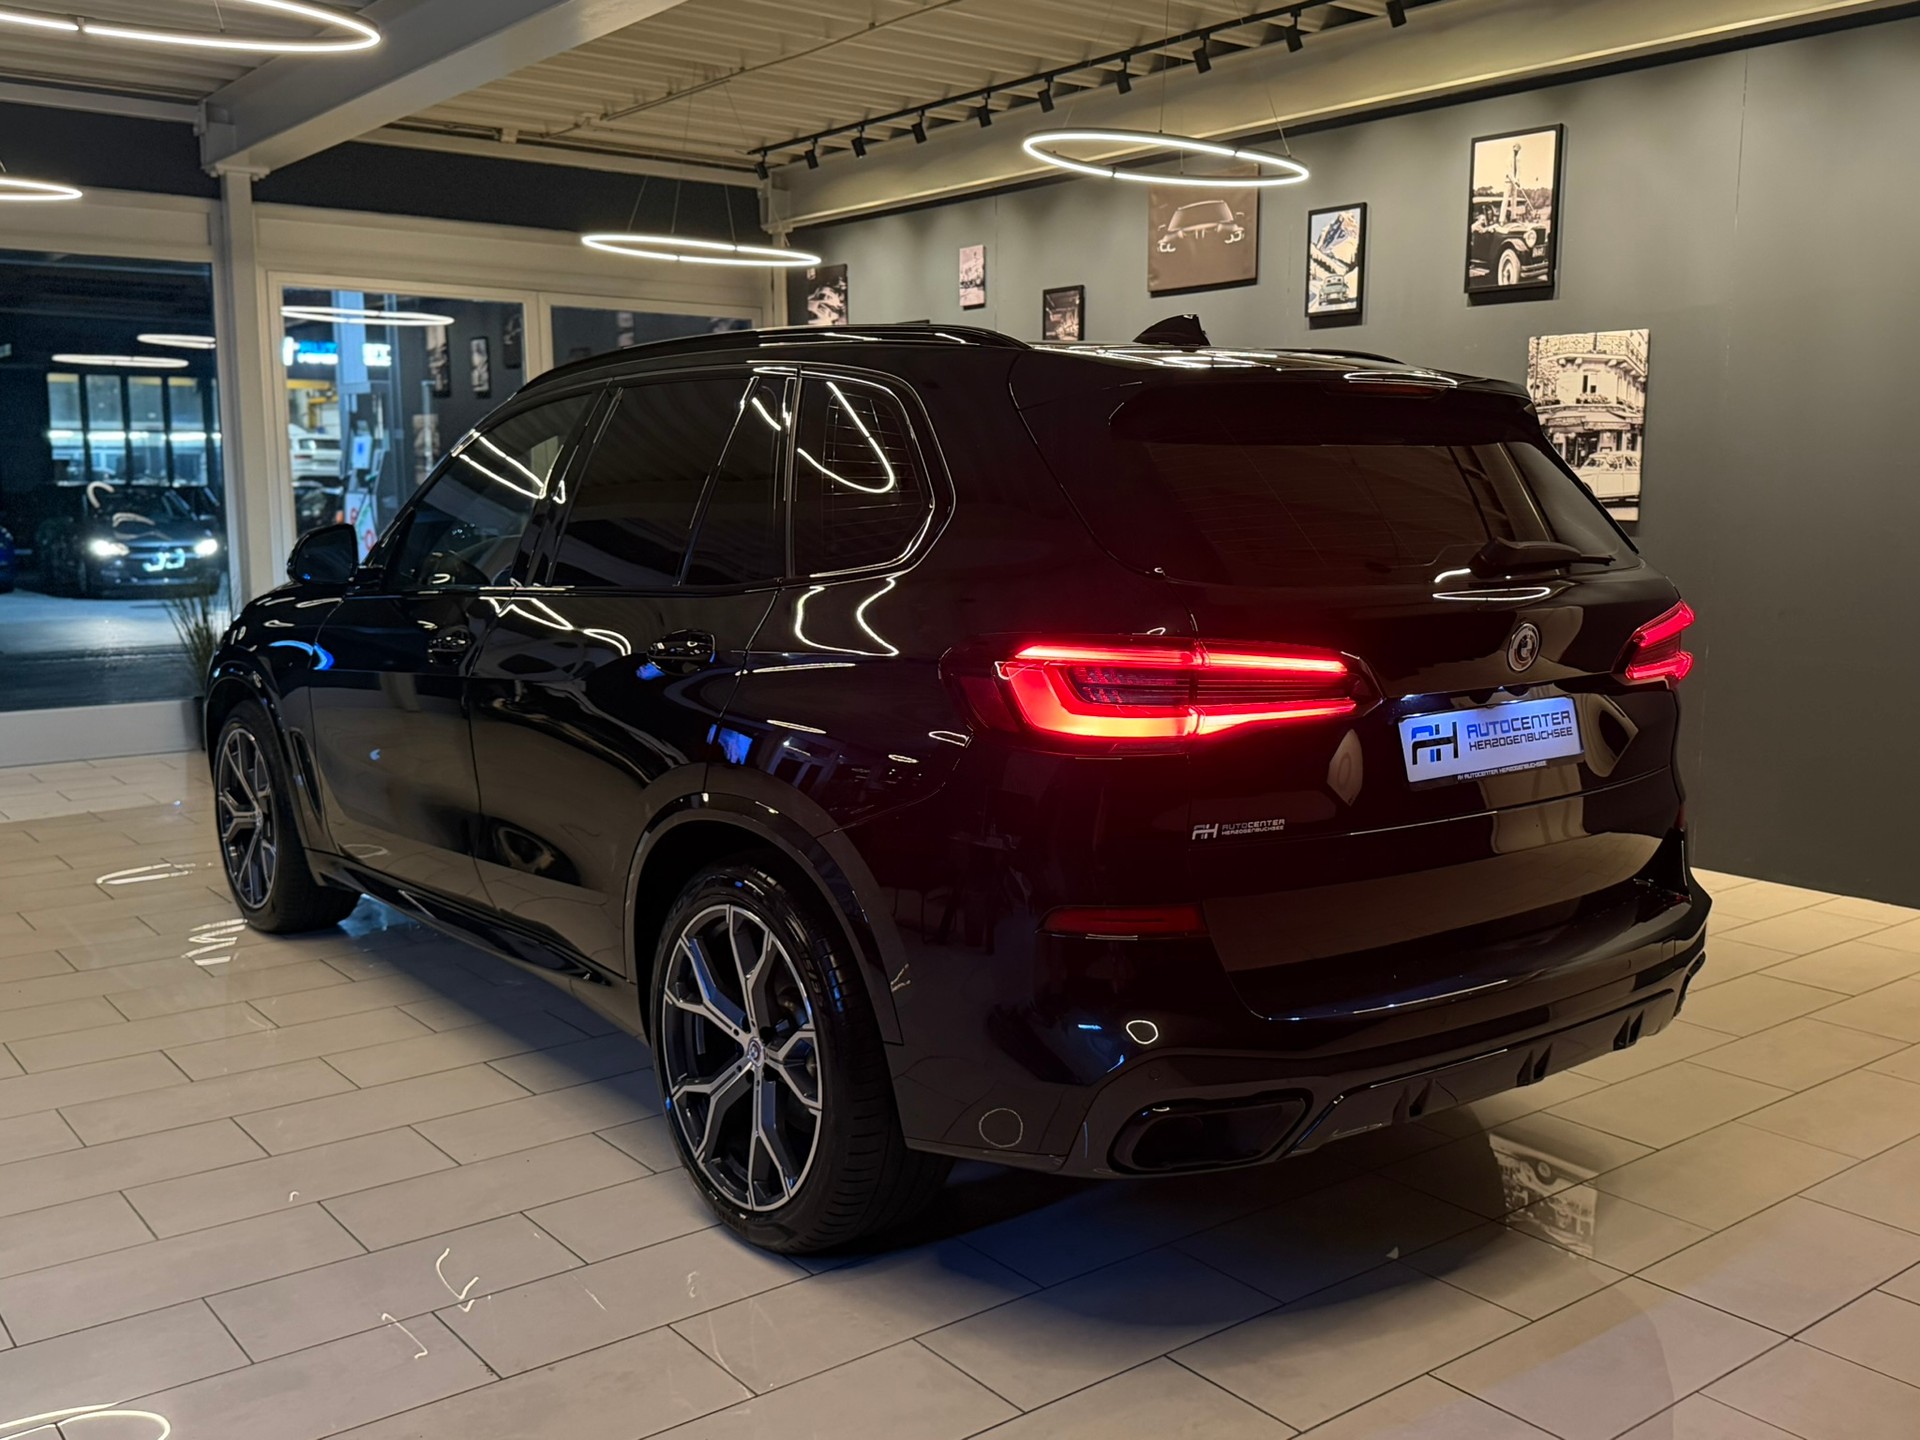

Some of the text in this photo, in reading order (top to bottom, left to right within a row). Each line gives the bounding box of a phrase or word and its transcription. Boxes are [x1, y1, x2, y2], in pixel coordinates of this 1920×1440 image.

[1466, 710, 1572, 739] AUTOCENTER
[1469, 726, 1574, 752] HERZOGENBUCHSEE
[1464, 769, 1498, 780] AUTOCENTER
[1499, 760, 1548, 775] HERZOGENBUCHSEE
[1221, 818, 1285, 830] AUTOCENTER
[1221, 825, 1285, 835] HERZOGENBUCHSEE
